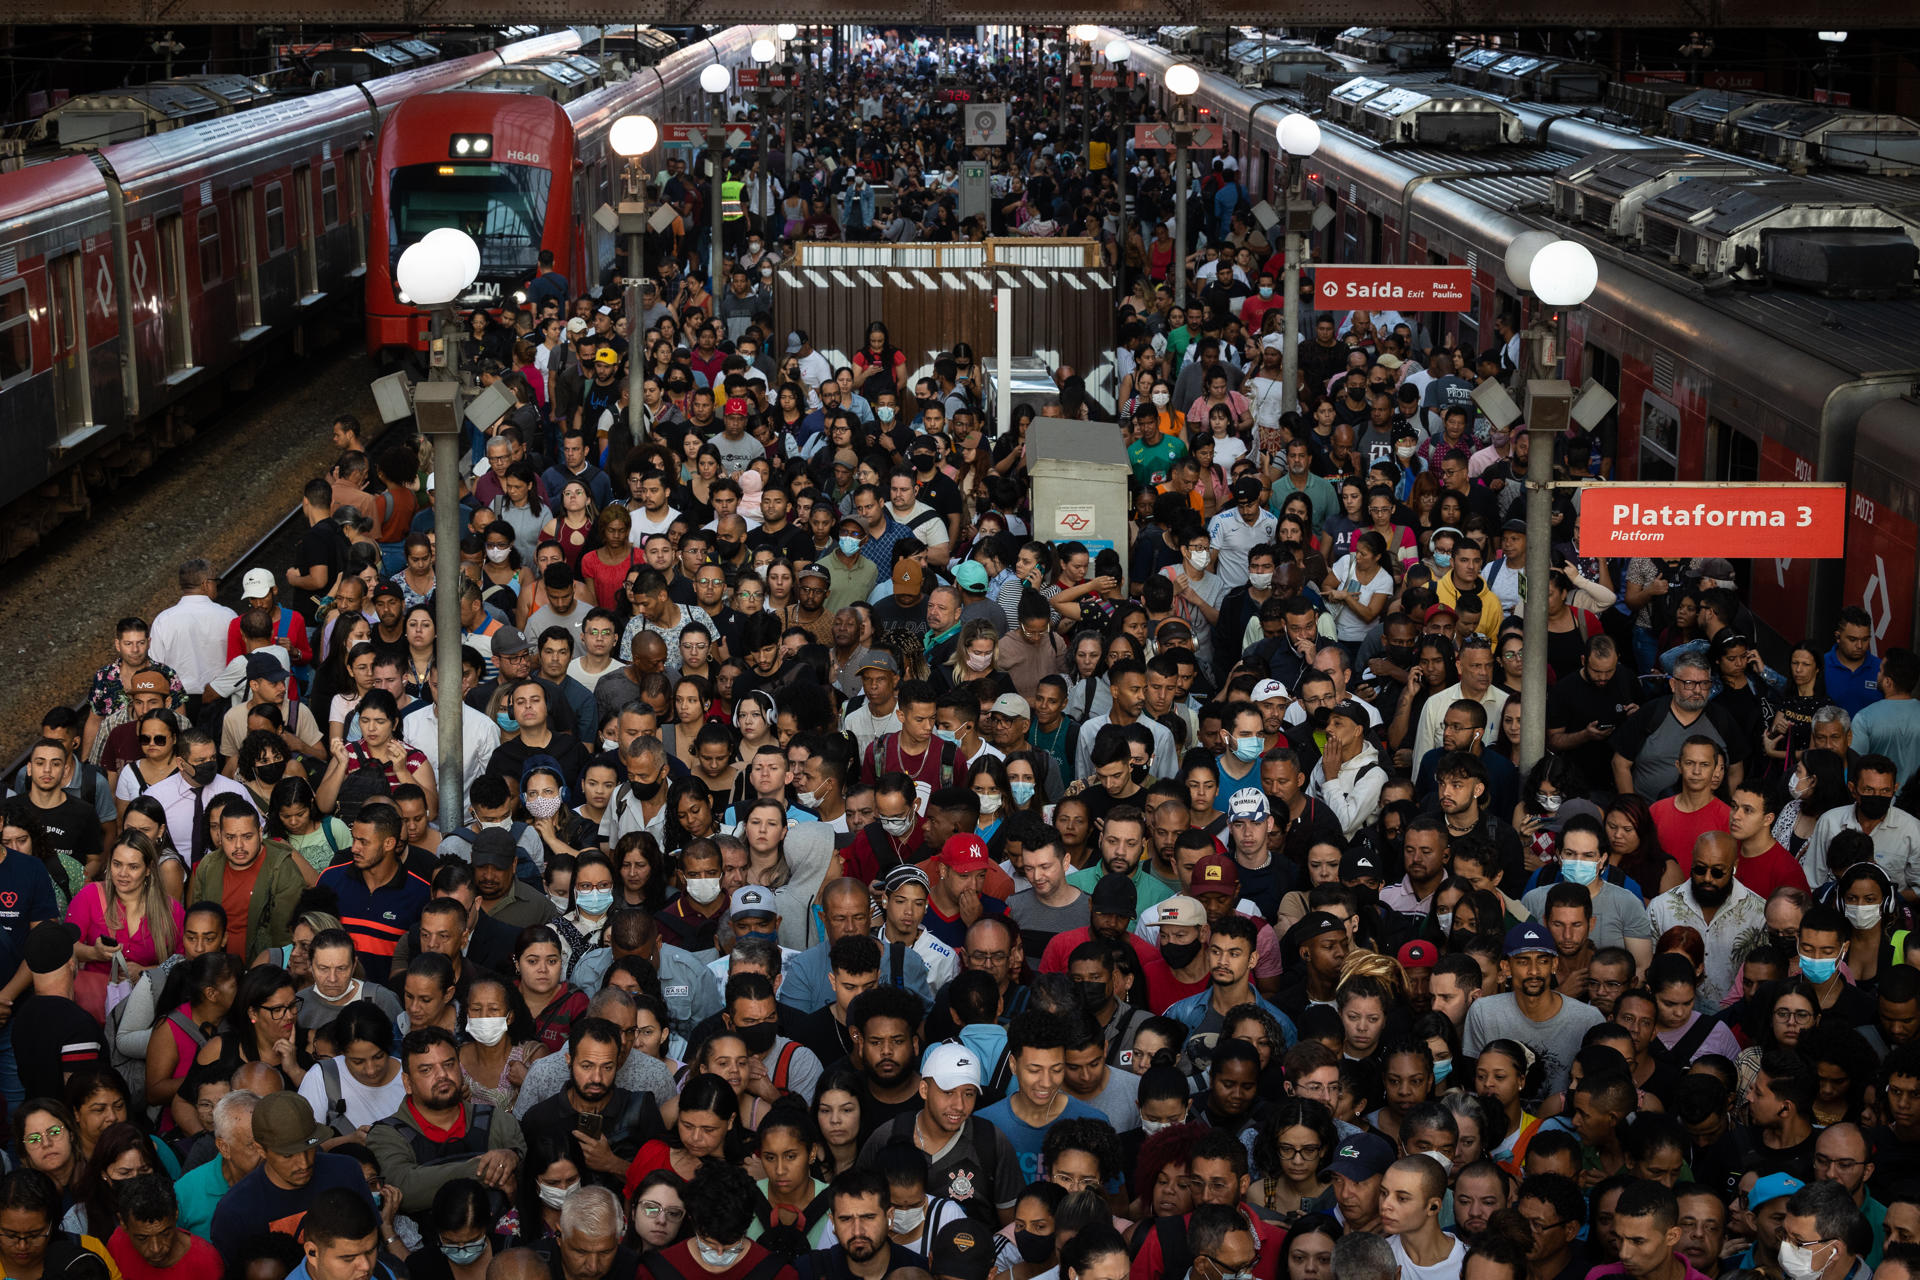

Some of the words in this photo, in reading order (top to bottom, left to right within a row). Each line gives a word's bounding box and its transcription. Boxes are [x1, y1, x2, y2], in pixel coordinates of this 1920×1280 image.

[1729, 76, 1752, 87] Luz
[507, 150, 540, 164] H640
[467, 282, 501, 297] TM
[1346, 282, 1404, 298] Saída
[1407, 290, 1425, 299] Exit
[1450, 282, 1456, 290] J.
[1432, 291, 1463, 299] Paulino
[1613, 503, 1786, 527] Plataforma
[1796, 506, 1813, 527] 3
[1854, 494, 1874, 525] P073
[1610, 529, 1664, 542] Platform
[929, 942, 951, 958] Itaú
